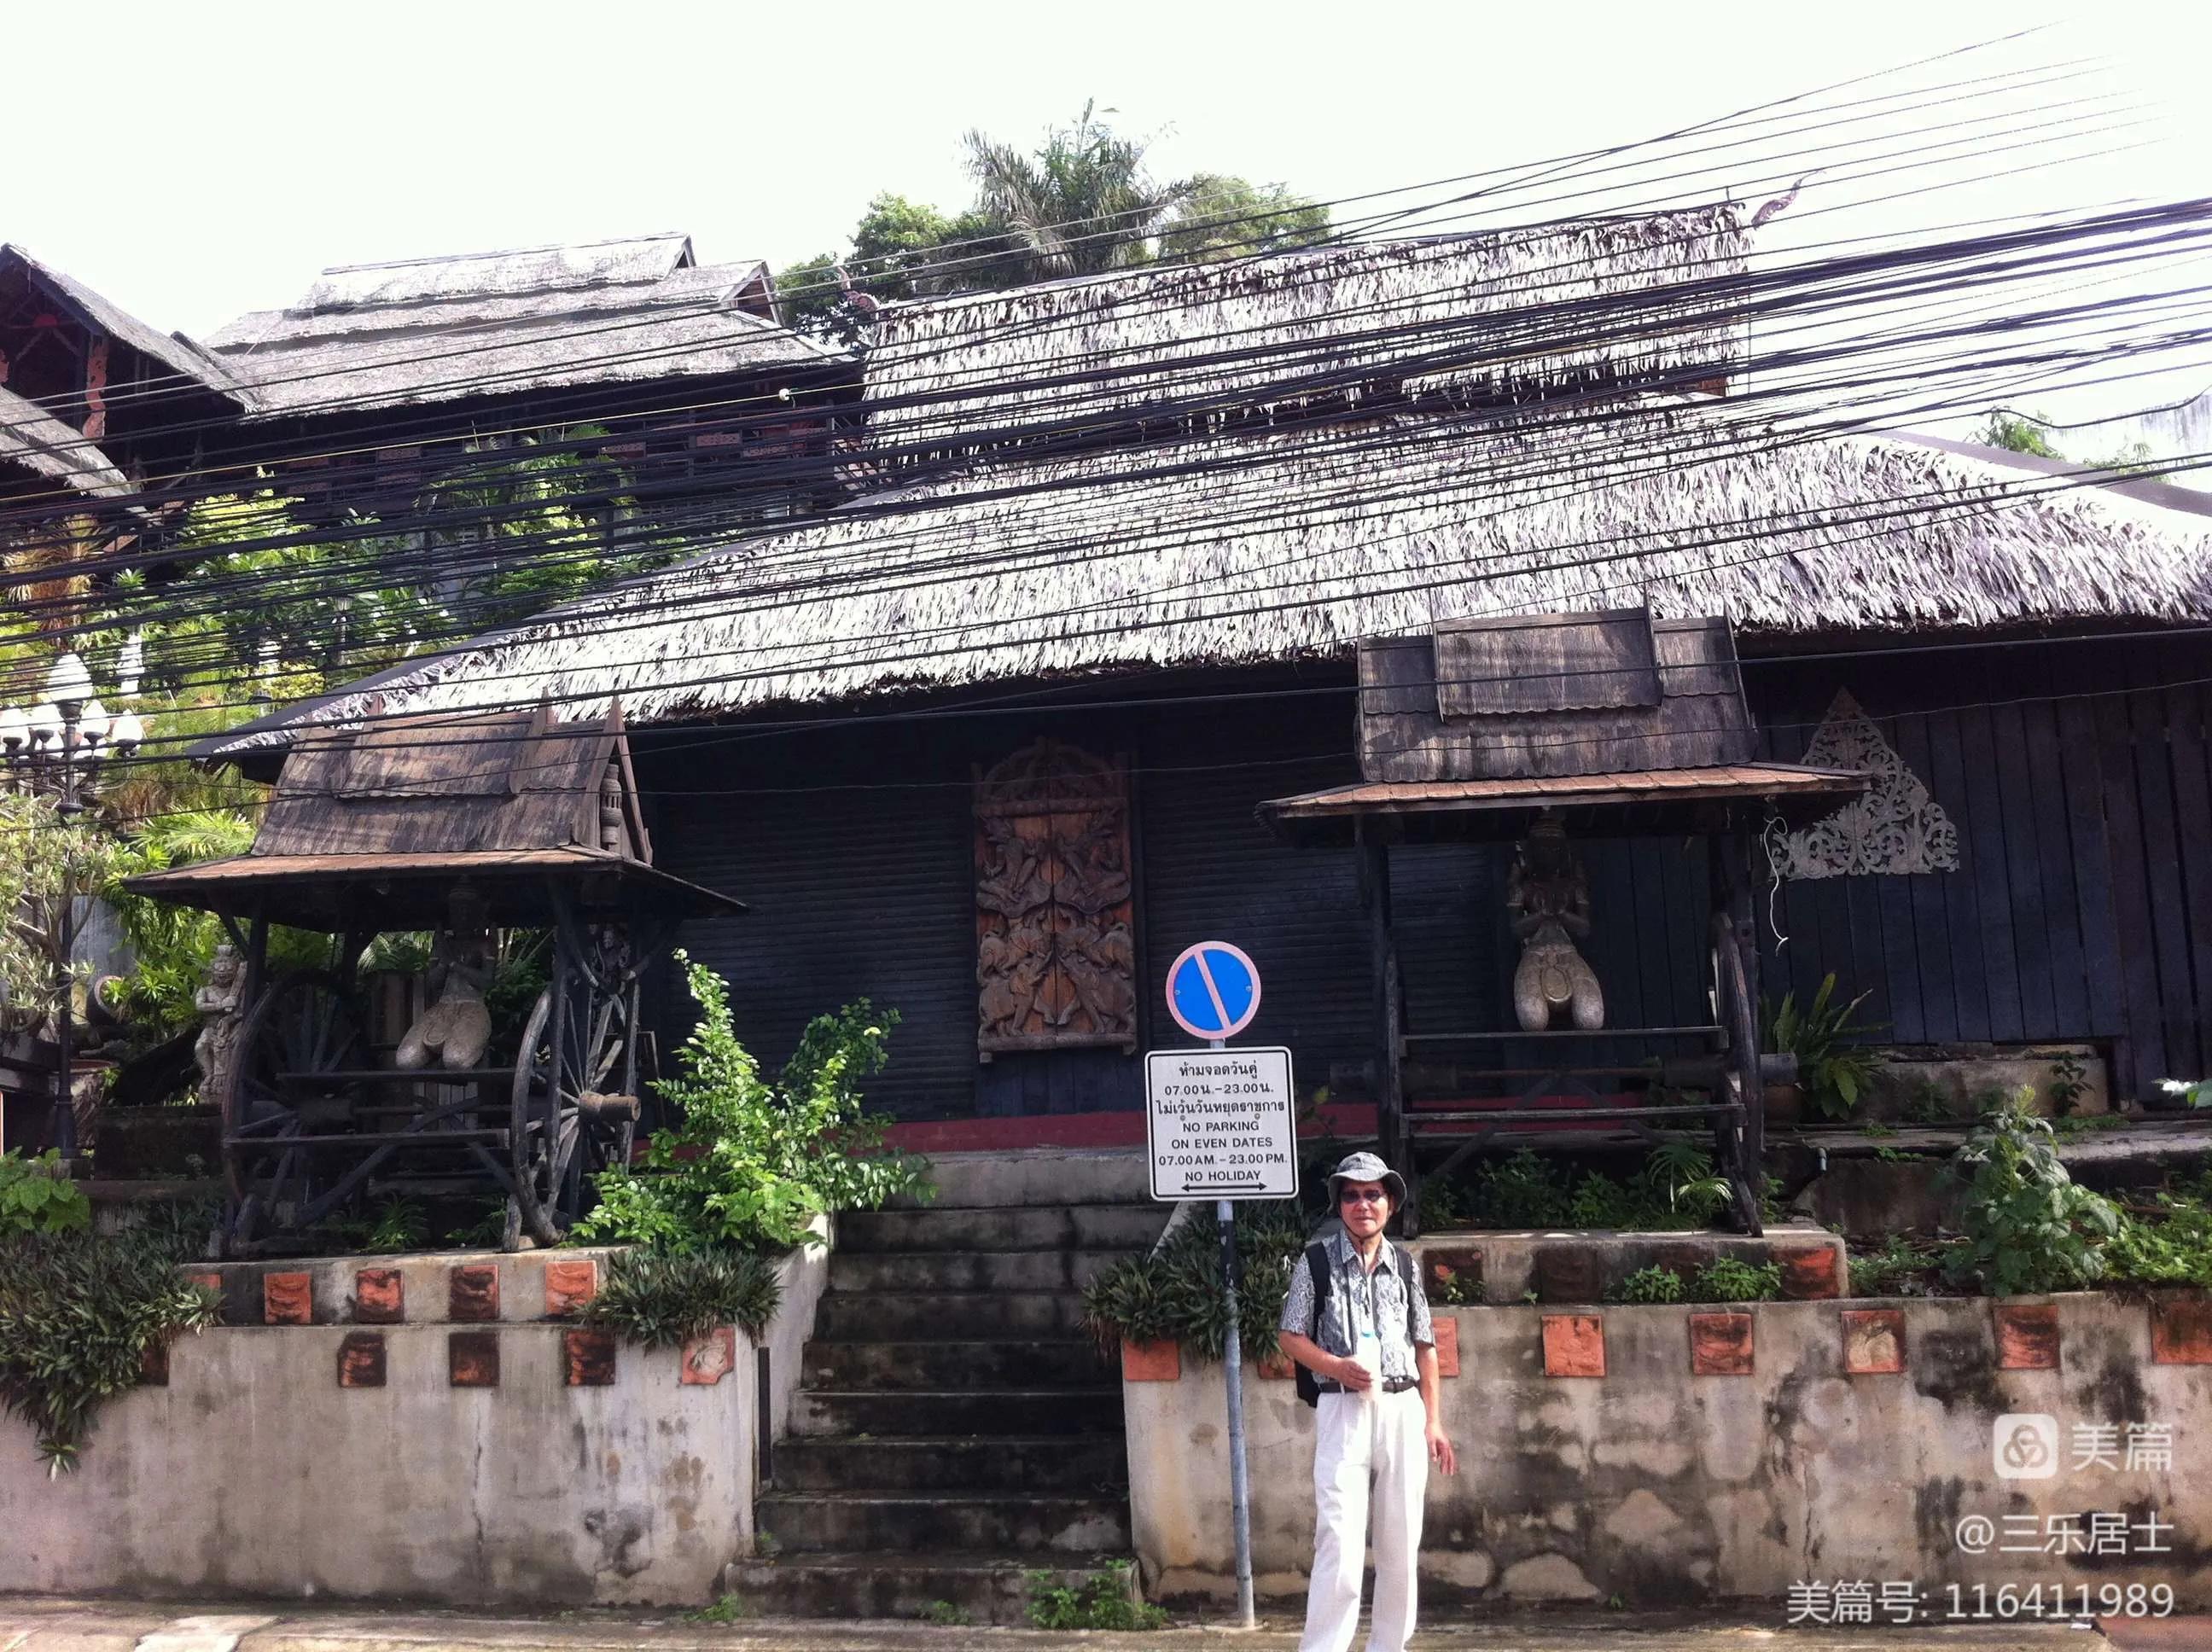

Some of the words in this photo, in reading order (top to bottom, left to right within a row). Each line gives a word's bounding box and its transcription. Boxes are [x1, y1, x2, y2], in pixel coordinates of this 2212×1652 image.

[1179, 1060, 1258, 1079] ห้ามจอดวันคู่
[1183, 1122, 1201, 1132] NO
[1206, 1120, 1260, 1131] PARKING
[1171, 1139, 1189, 1149] ON
[1195, 1138, 1227, 1149] EVEN
[1232, 1137, 1273, 1148] DATES
[1185, 1171, 1202, 1181] NO
[1208, 1170, 1261, 1181] HOLIDAY
